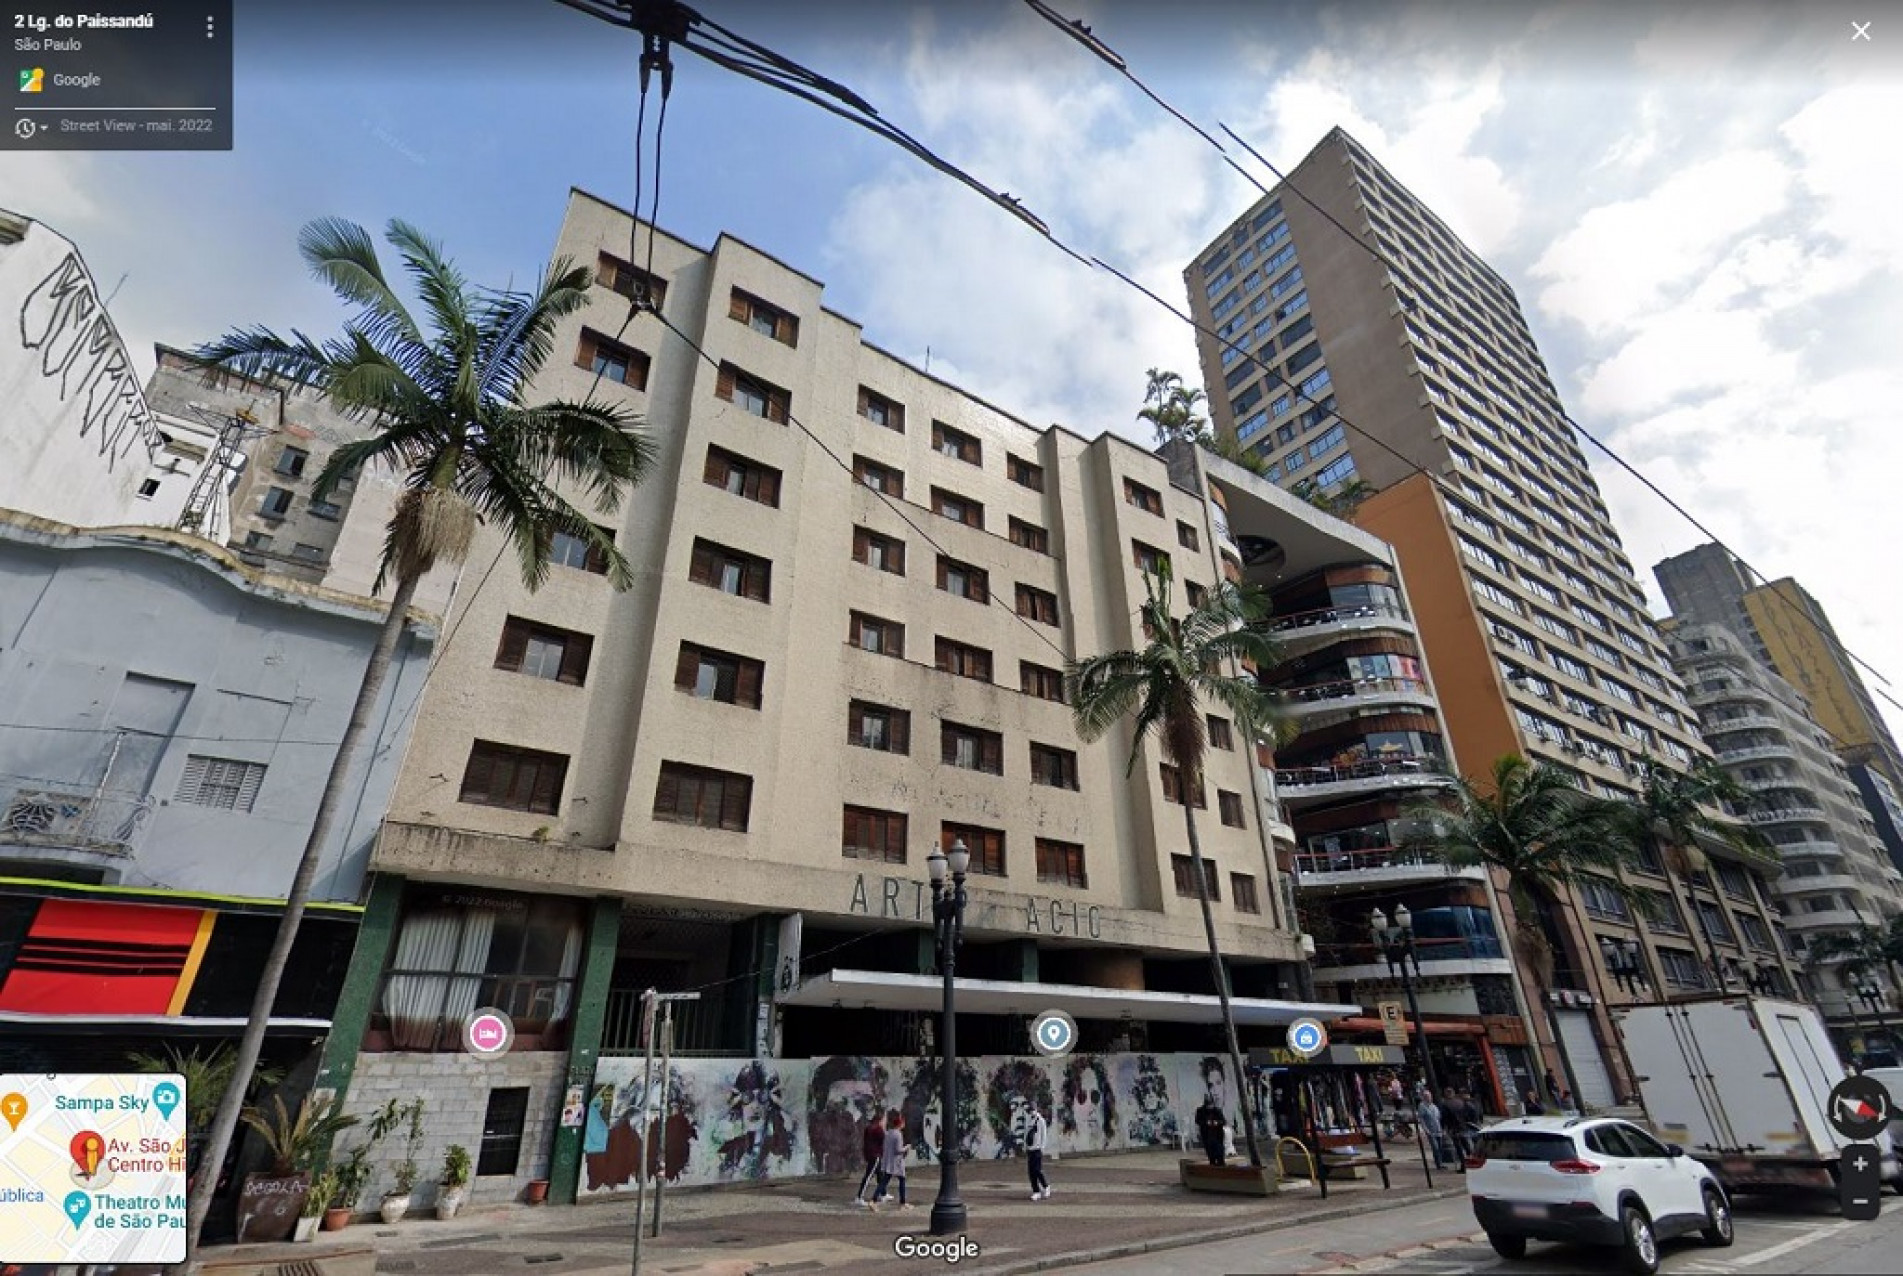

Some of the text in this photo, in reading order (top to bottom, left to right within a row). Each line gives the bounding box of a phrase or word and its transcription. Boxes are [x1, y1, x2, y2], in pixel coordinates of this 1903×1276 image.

[850, 873, 924, 920] ART
[1386, 1006, 1397, 1020] E
[1355, 1046, 1385, 1063] TAXI
